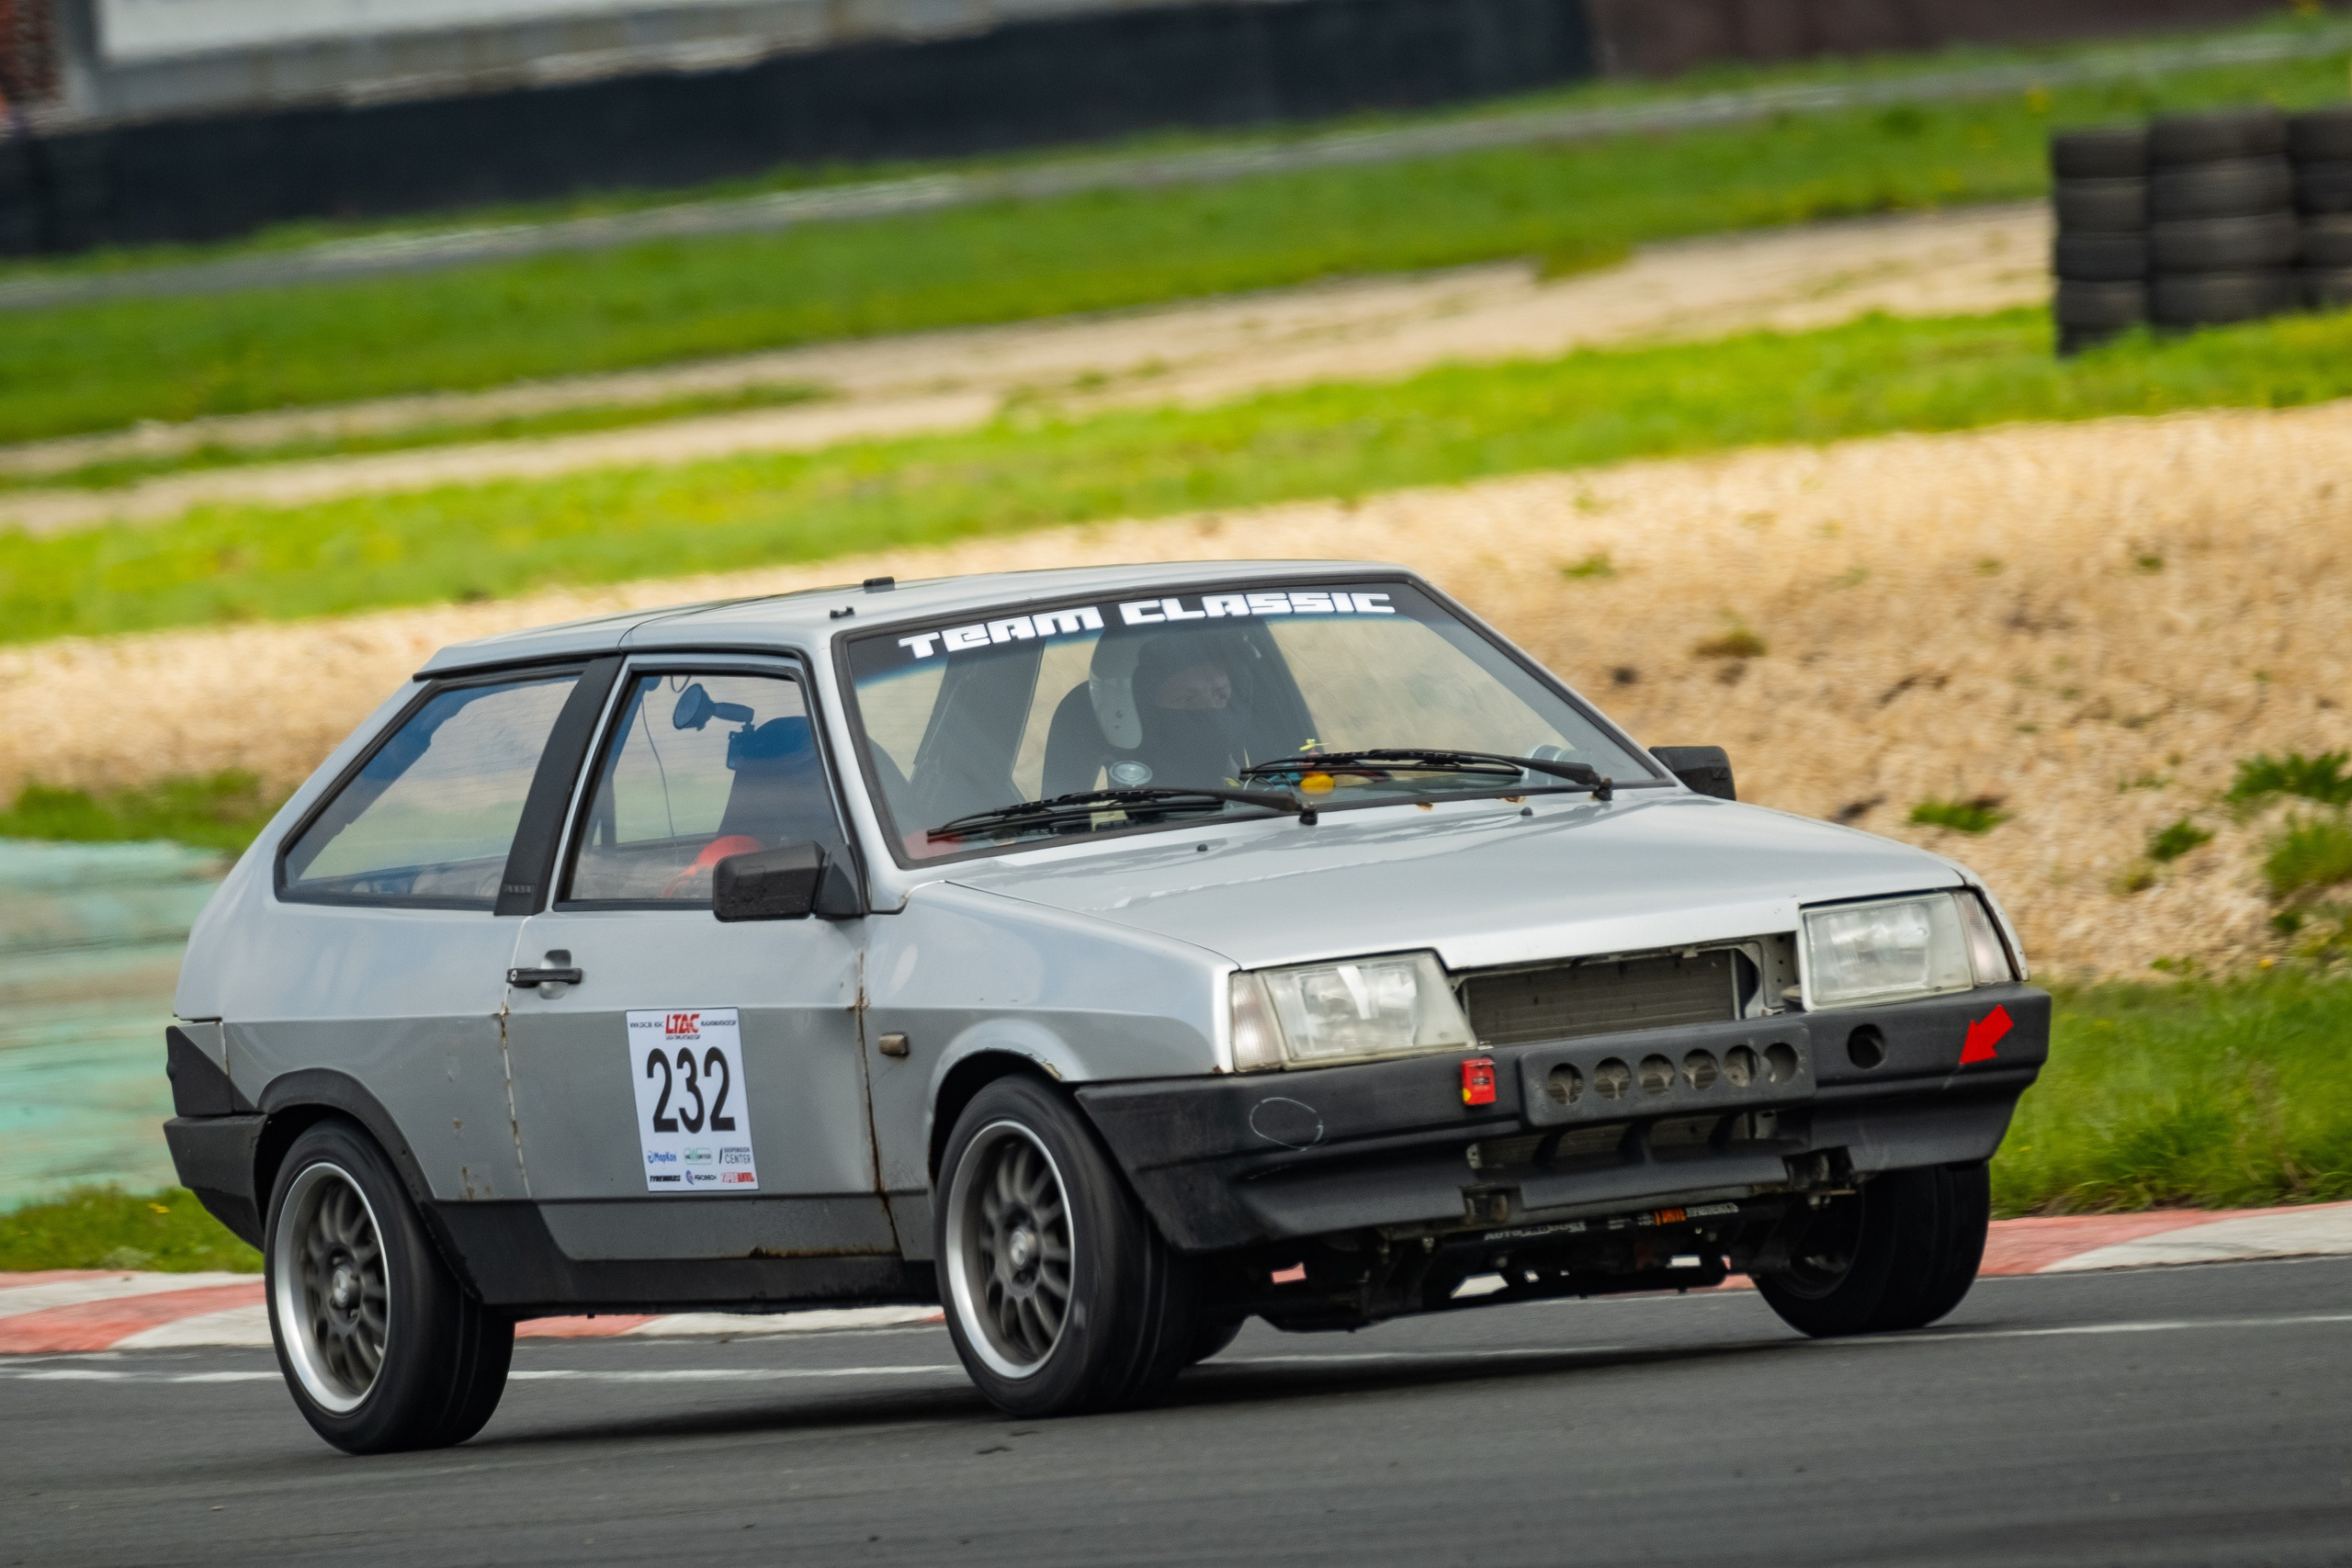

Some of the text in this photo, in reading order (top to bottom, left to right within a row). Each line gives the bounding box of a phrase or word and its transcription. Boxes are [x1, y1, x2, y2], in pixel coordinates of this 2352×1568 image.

[898, 592, 1396, 660] TEAM CLASSIC
[665, 1013, 701, 1034] LTAC
[647, 1045, 736, 1134] 232
